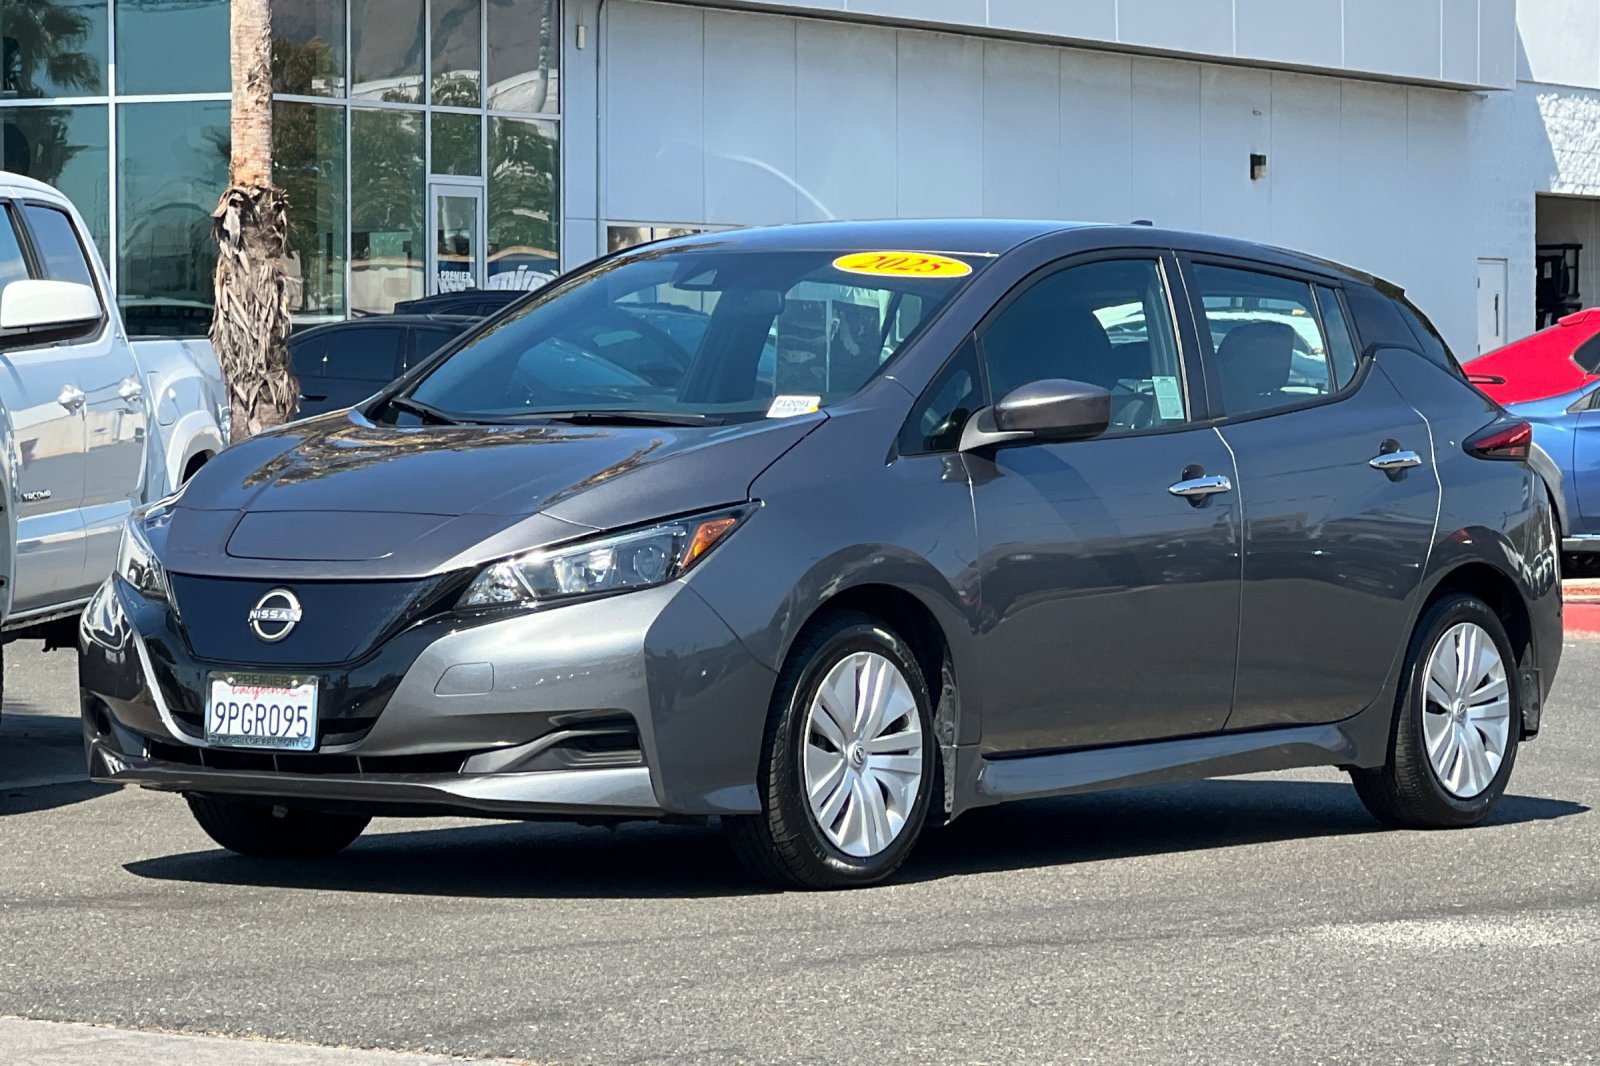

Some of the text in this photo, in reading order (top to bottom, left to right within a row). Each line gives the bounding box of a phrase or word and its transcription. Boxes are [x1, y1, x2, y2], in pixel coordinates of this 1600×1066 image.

[850, 256, 953, 272] 2025
[249, 609, 302, 621] NISSAN
[236, 674, 290, 686] PREMIER
[214, 702, 308, 737] 9PGR095
